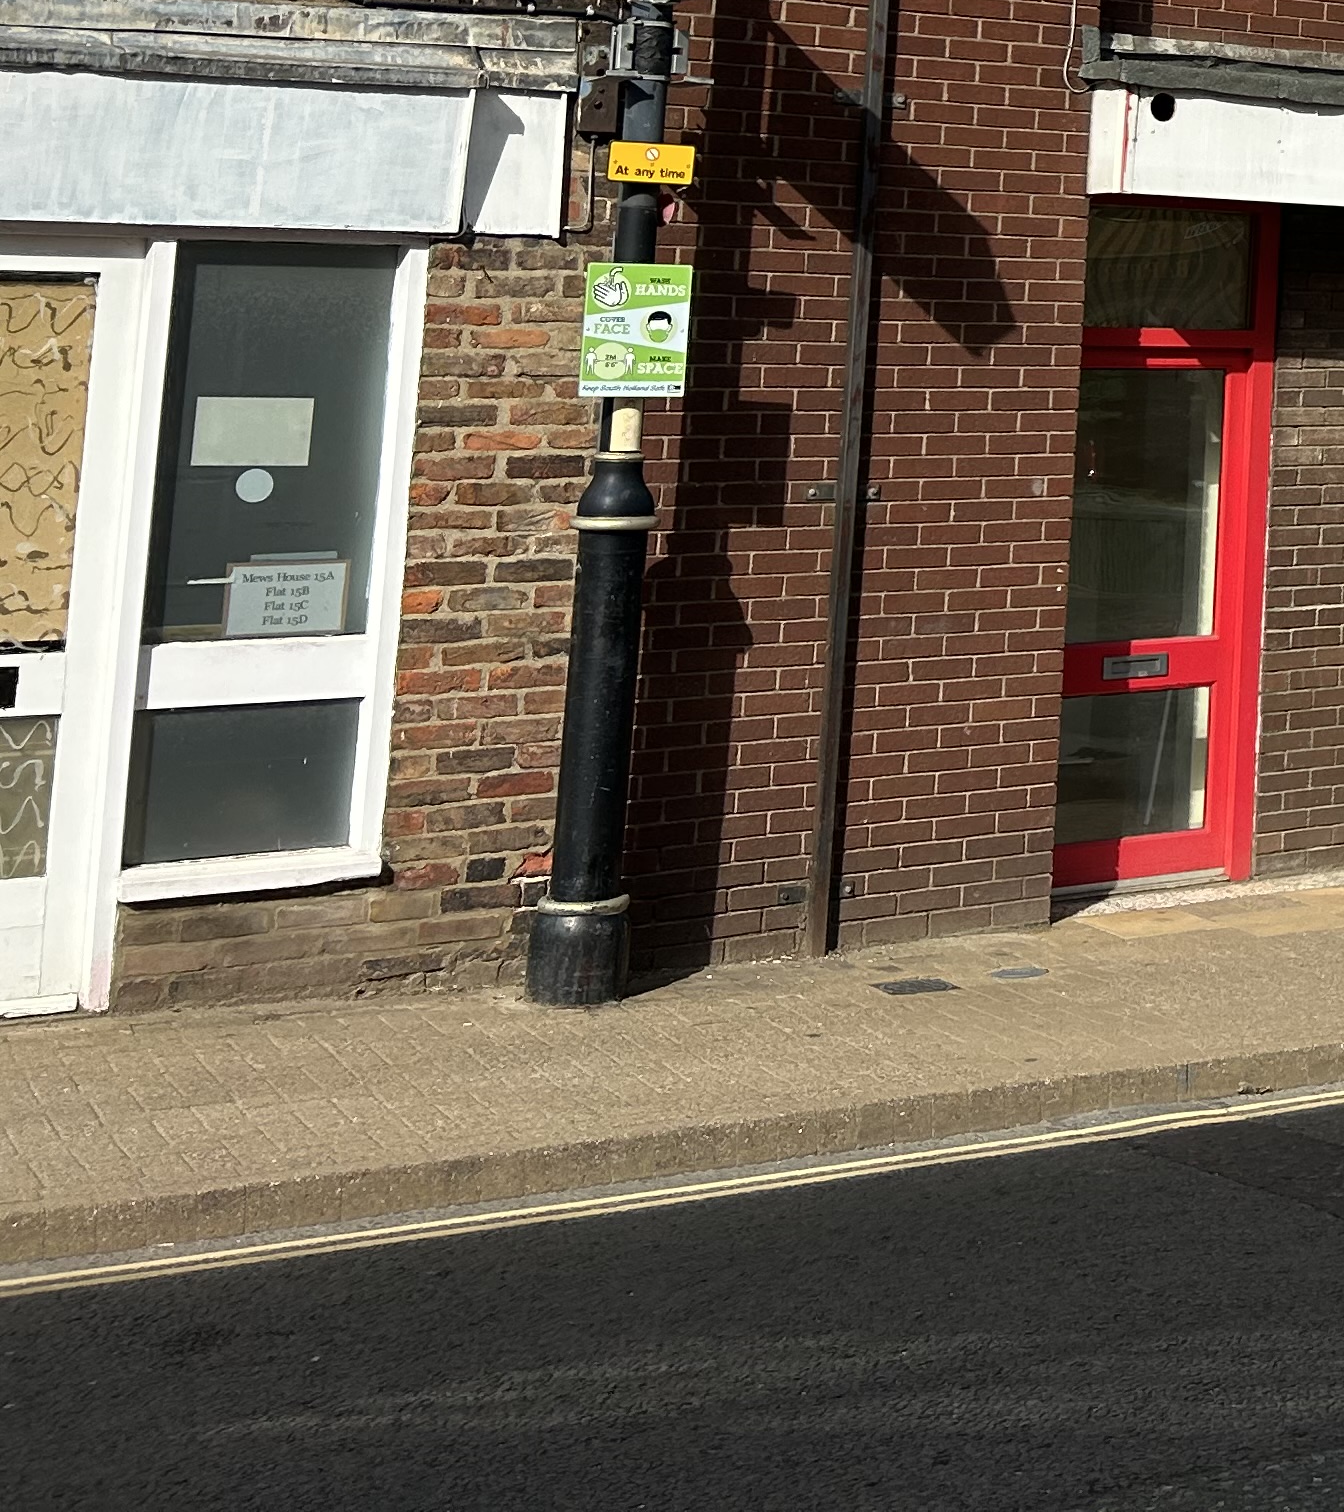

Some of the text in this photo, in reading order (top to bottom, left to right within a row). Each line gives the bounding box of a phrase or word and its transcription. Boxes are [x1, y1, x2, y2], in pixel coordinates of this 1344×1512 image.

[614, 164, 686, 179] At any time
[634, 283, 687, 297] HANDS
[593, 323, 631, 335] FACE
[649, 355, 672, 363] MAKE
[637, 362, 685, 375] SPACE
[582, 384, 600, 393] Keep
[600, 384, 622, 392] South
[623, 384, 650, 392] Holland
[241, 571, 335, 584] Mews House 15A
[265, 585, 310, 598] Flat 15B
[264, 599, 310, 612] Flat 15C
[262, 614, 309, 627] Flat 15D
